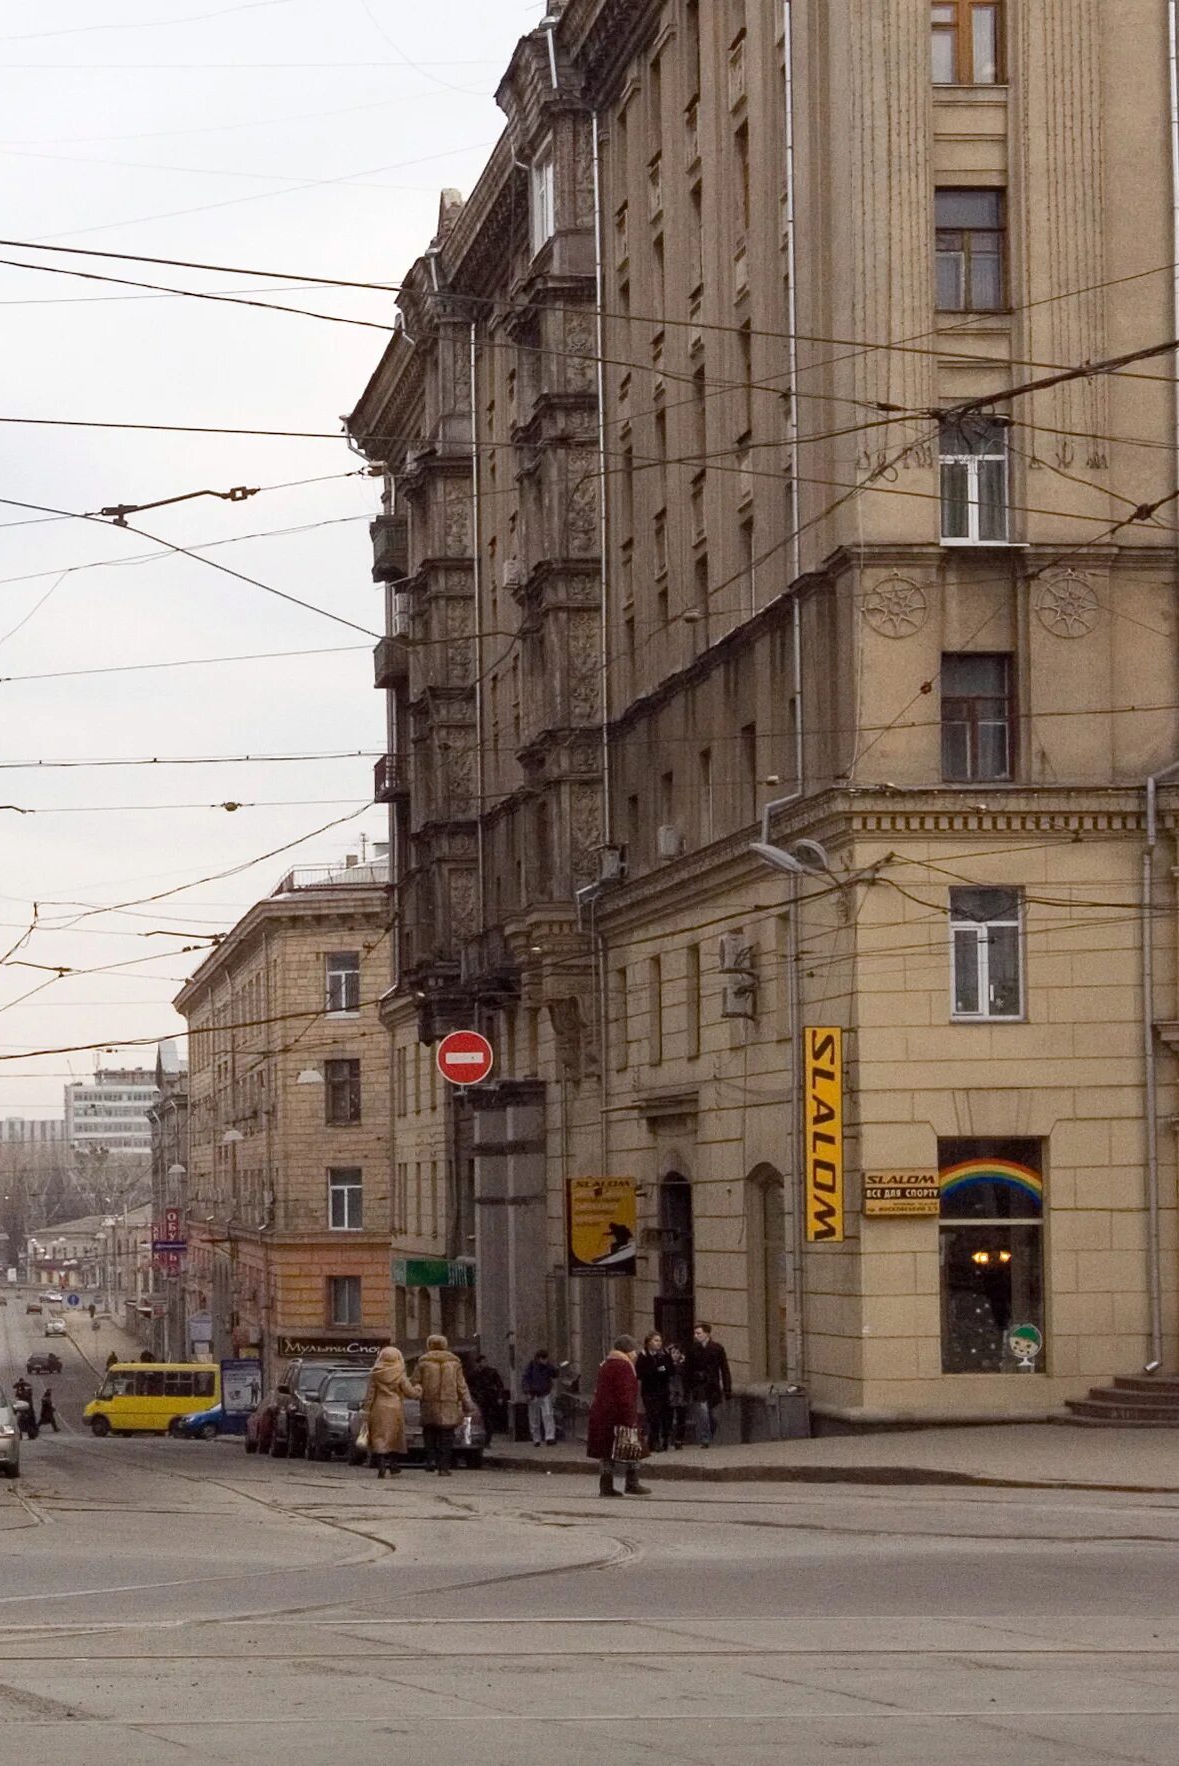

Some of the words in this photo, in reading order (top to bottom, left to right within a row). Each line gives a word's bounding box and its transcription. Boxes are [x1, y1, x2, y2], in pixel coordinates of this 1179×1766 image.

[812, 1030, 836, 1240] SLALOM
[866, 1175, 935, 1184] SLALOM
[866, 1189, 882, 1198] ВСЕ
[884, 1189, 901, 1198] ДЛЯ
[905, 1189, 939, 1198] СПОРТУ
[167, 1212, 177, 1261] ОБУЬ
